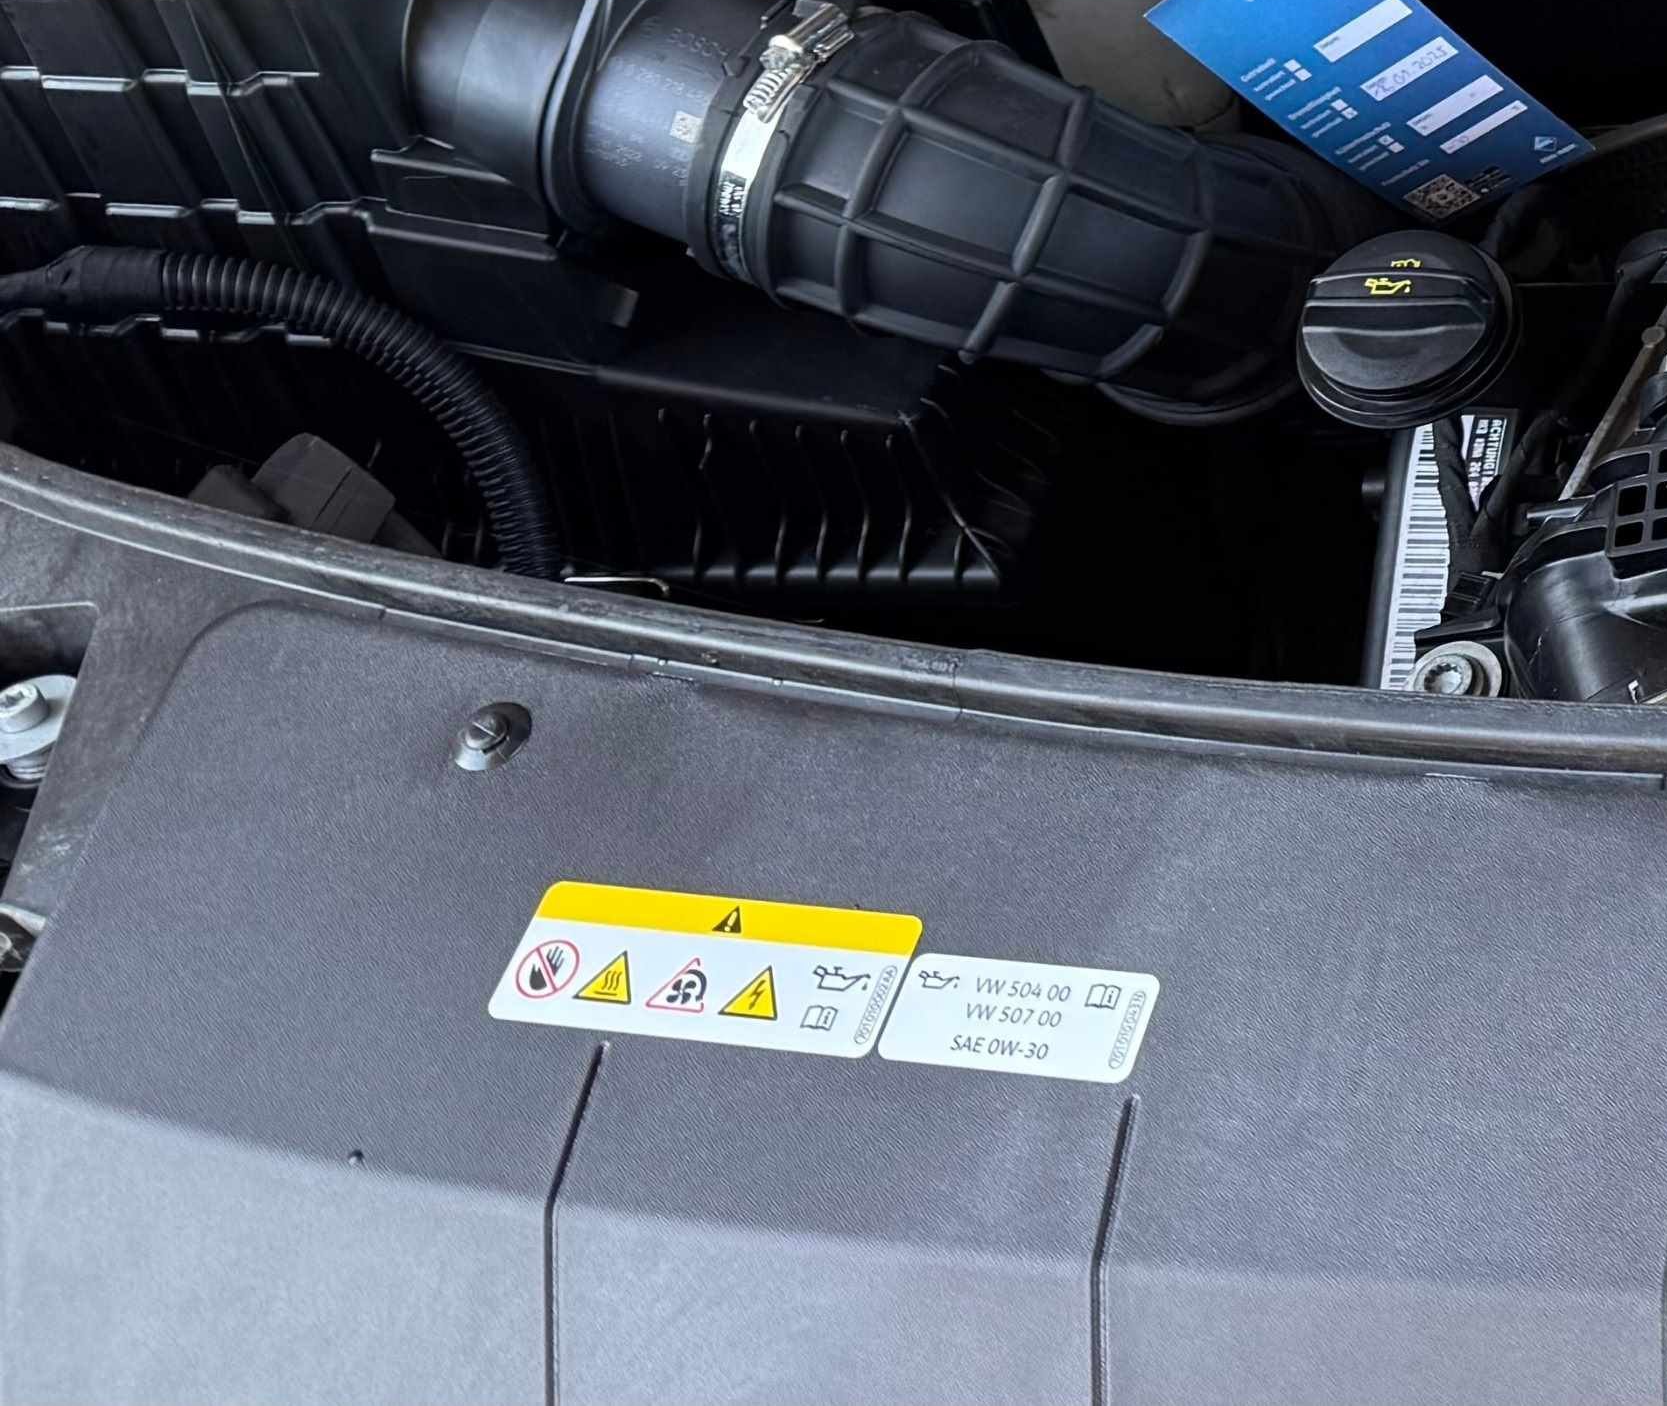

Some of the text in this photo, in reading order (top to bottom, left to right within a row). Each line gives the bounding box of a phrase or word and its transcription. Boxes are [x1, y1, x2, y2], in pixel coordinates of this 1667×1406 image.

[976, 977, 1071, 1002] VW 504 00
[966, 1002, 1062, 1028] VW 507 00
[951, 1035, 1049, 1060] SAE 0W-30
